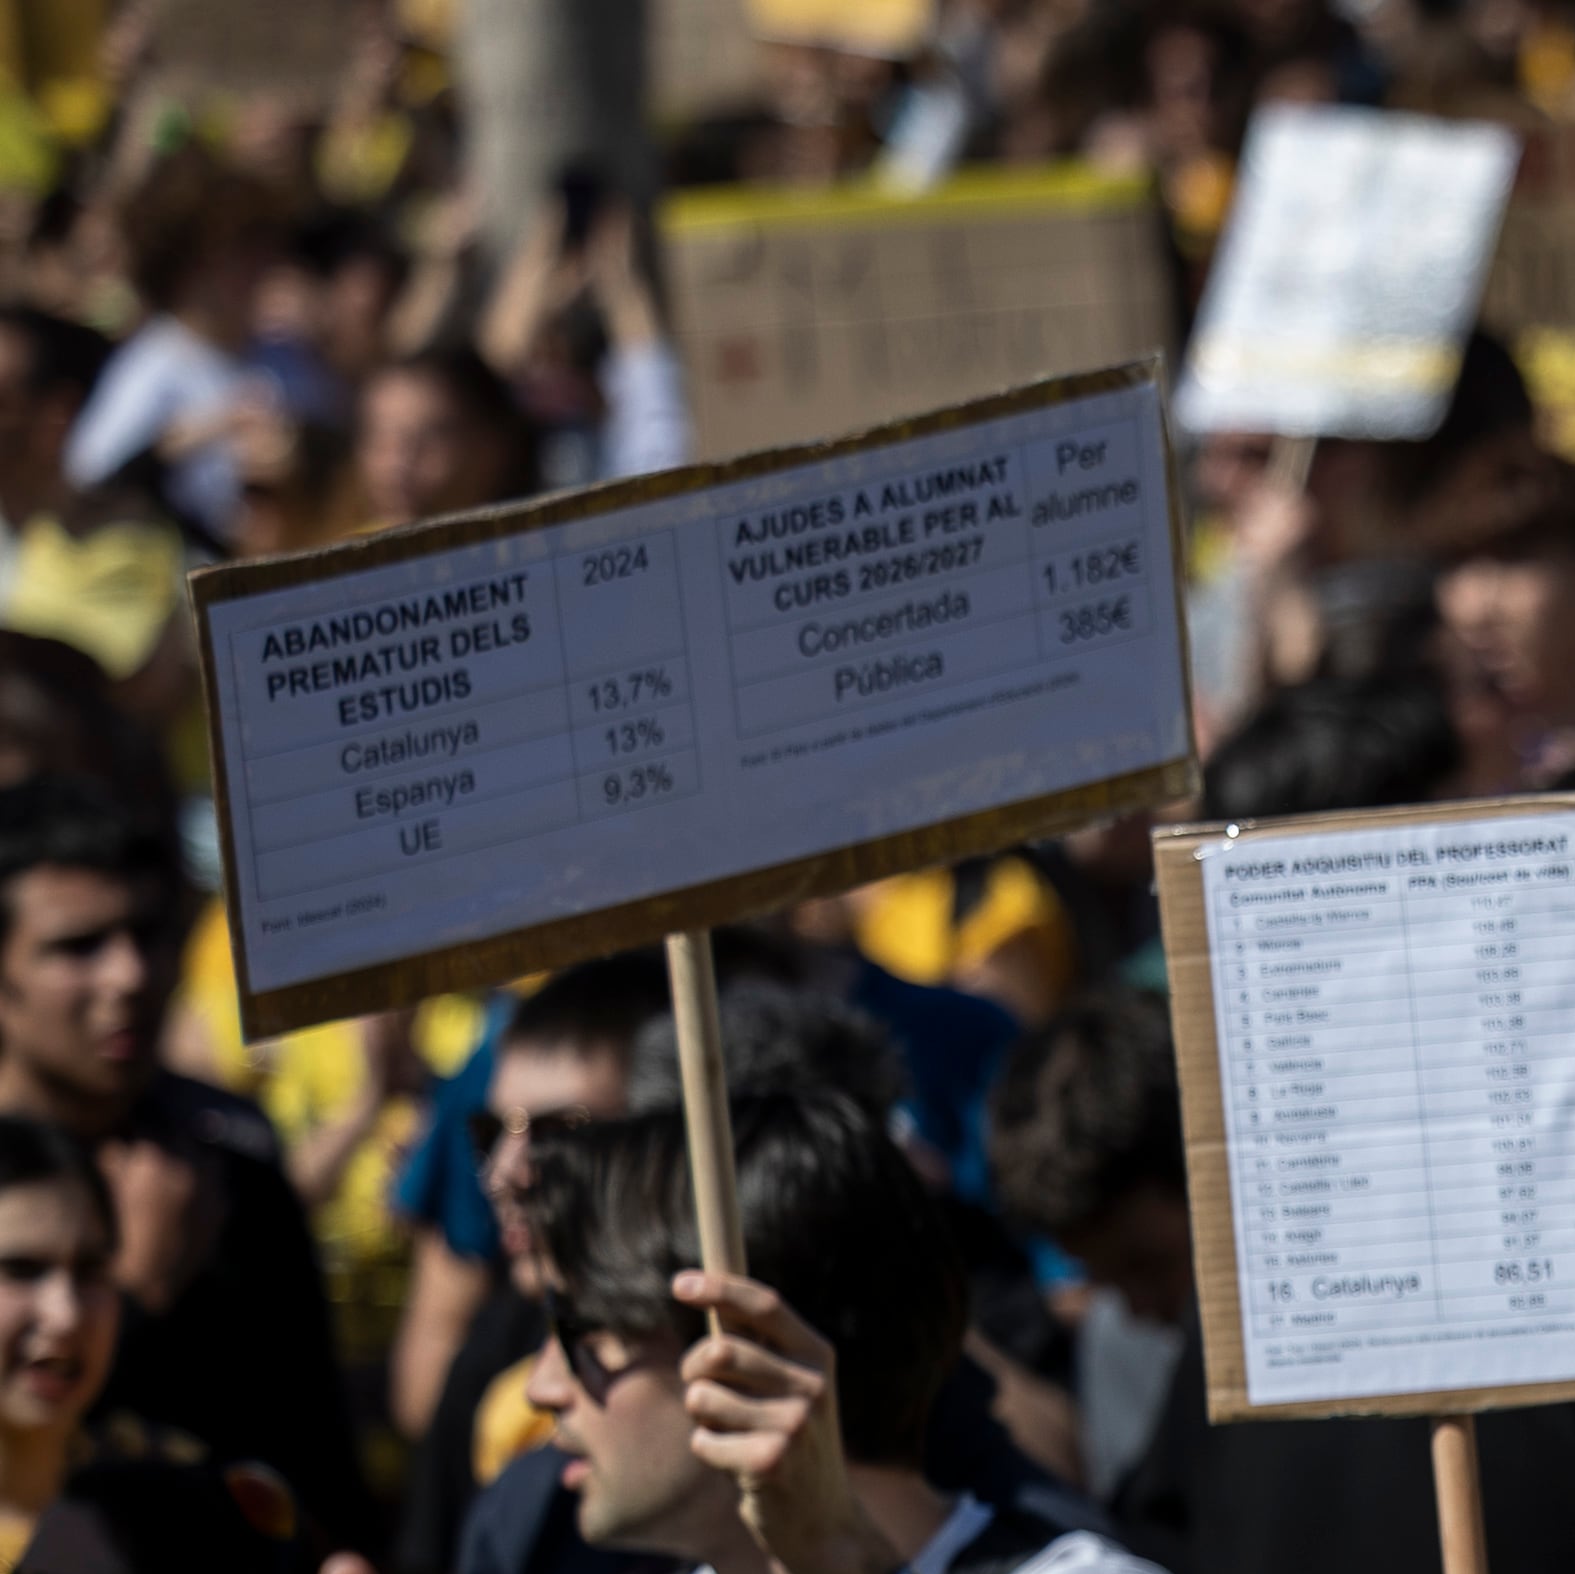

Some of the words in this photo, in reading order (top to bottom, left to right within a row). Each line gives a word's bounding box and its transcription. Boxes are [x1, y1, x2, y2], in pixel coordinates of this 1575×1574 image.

[734, 496, 845, 549] AJUDES
[852, 491, 875, 521] A
[879, 456, 1010, 514] ALUMNAT
[1030, 479, 1138, 529] alumne
[1055, 438, 1108, 478] Per
[728, 521, 917, 586] VULNERABLE
[923, 506, 980, 538] PER
[985, 494, 1022, 523] AL
[774, 570, 851, 613] CURS
[858, 536, 985, 591] 2026/2027
[260, 573, 529, 664] ABANDONAMENT
[582, 544, 650, 588] 2024
[798, 590, 971, 658] Concertada
[1042, 540, 1142, 597] 1.182€
[266, 634, 443, 702] PREMATUR
[450, 612, 532, 660] DELS
[834, 649, 944, 702] Pública
[1058, 594, 1135, 646] 385€
[337, 669, 473, 728] ESTUDIS
[340, 719, 481, 775] Catalunya
[588, 667, 673, 713] 13,7%
[354, 768, 477, 820] Espanya
[604, 716, 665, 757] 13%
[398, 818, 443, 857] UE
[602, 762, 674, 805] 9,3%
[1396, 848, 1432, 867] DEL
[1311, 1271, 1422, 1301] Catalunya
